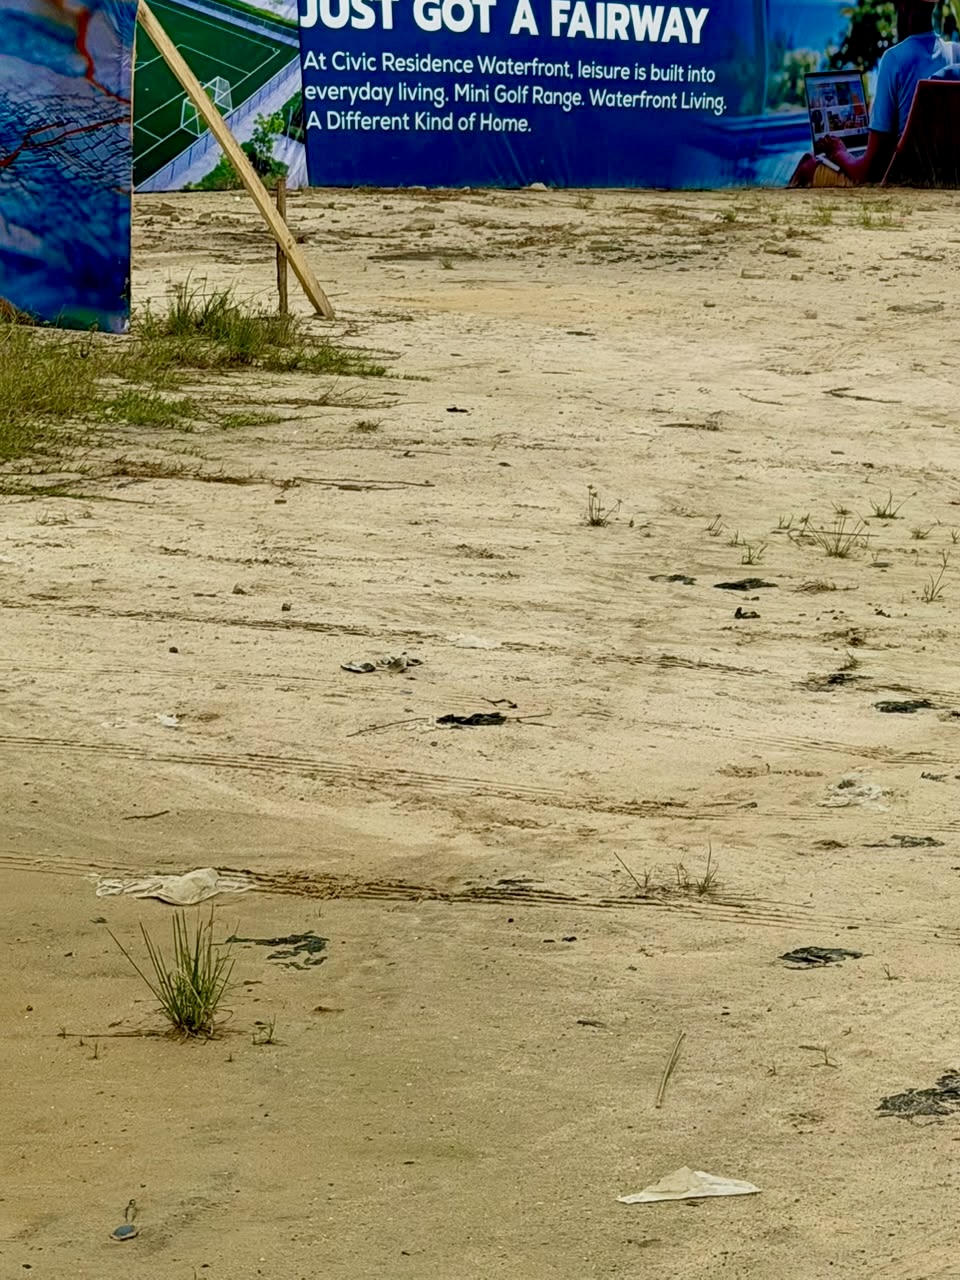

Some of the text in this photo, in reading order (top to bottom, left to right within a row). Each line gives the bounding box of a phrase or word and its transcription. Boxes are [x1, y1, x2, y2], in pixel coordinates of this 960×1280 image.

[551, 0, 710, 44] FAIRWAY
[304, 50, 716, 82] At Civic Residence Waterfront, leisure is built into
[304, 82, 727, 116] everyday living. Mini Golf Range. Waterfront Living.
[306, 110, 532, 132] A Different Kind of Home.
